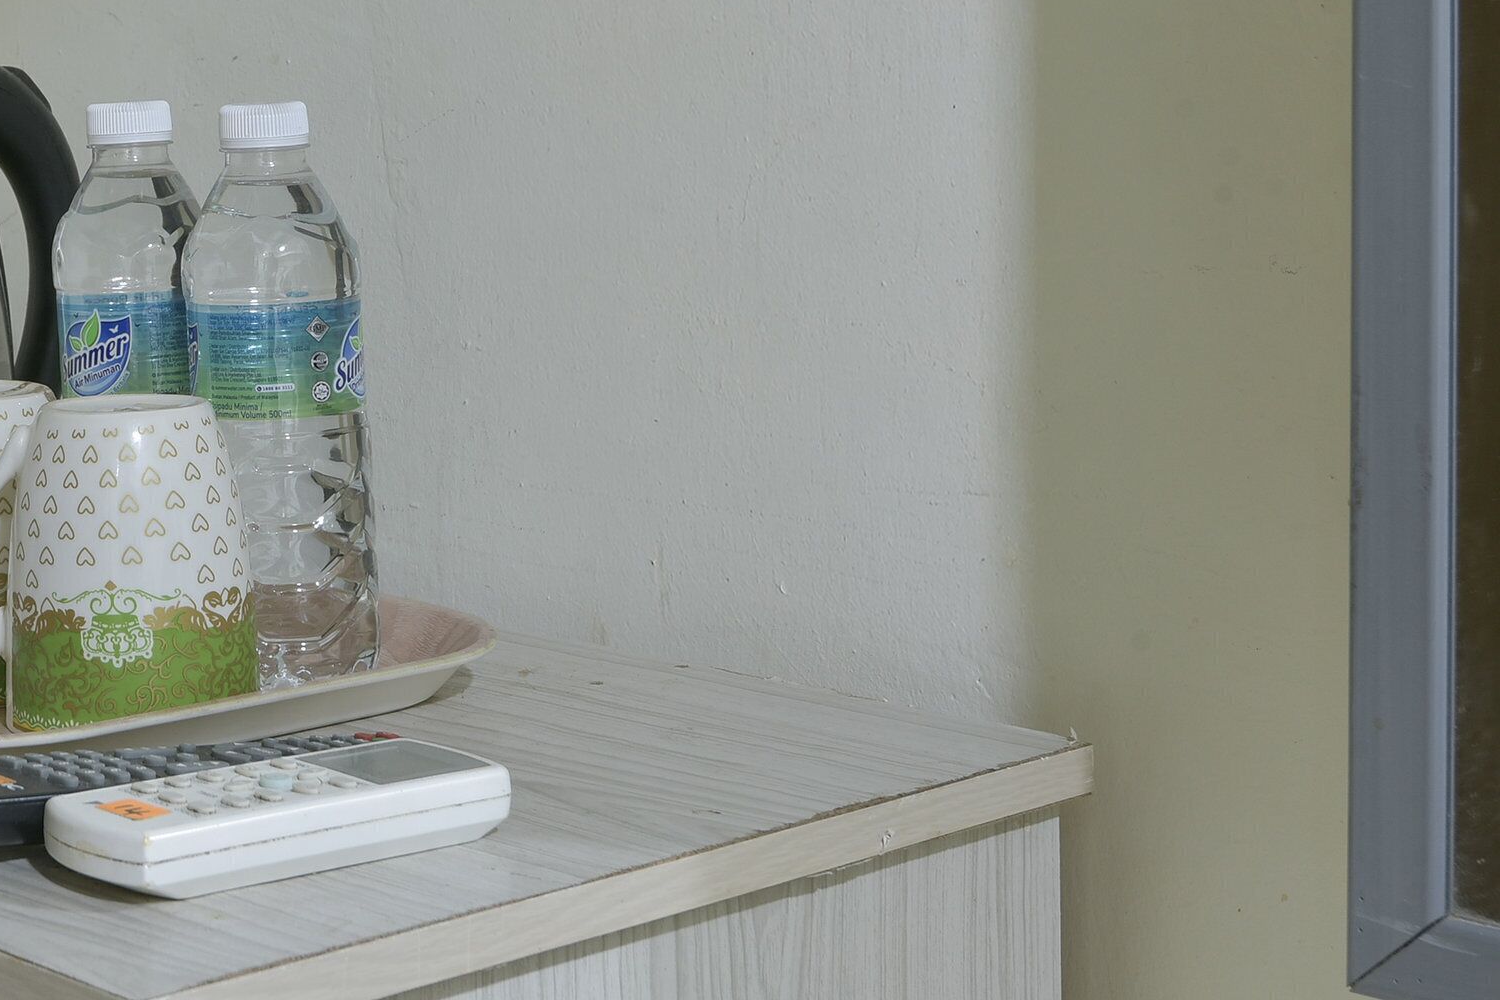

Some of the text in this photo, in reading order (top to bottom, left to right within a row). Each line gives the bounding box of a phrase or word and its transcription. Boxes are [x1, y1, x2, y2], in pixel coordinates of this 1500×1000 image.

[64, 335, 127, 382] Summer
[336, 351, 362, 391] Sum
[74, 378, 84, 389] Air
[84, 364, 121, 384] Minuman
[234, 402, 259, 411] Minima
[240, 411, 267, 419] Volume
[268, 409, 292, 418] 500ml
